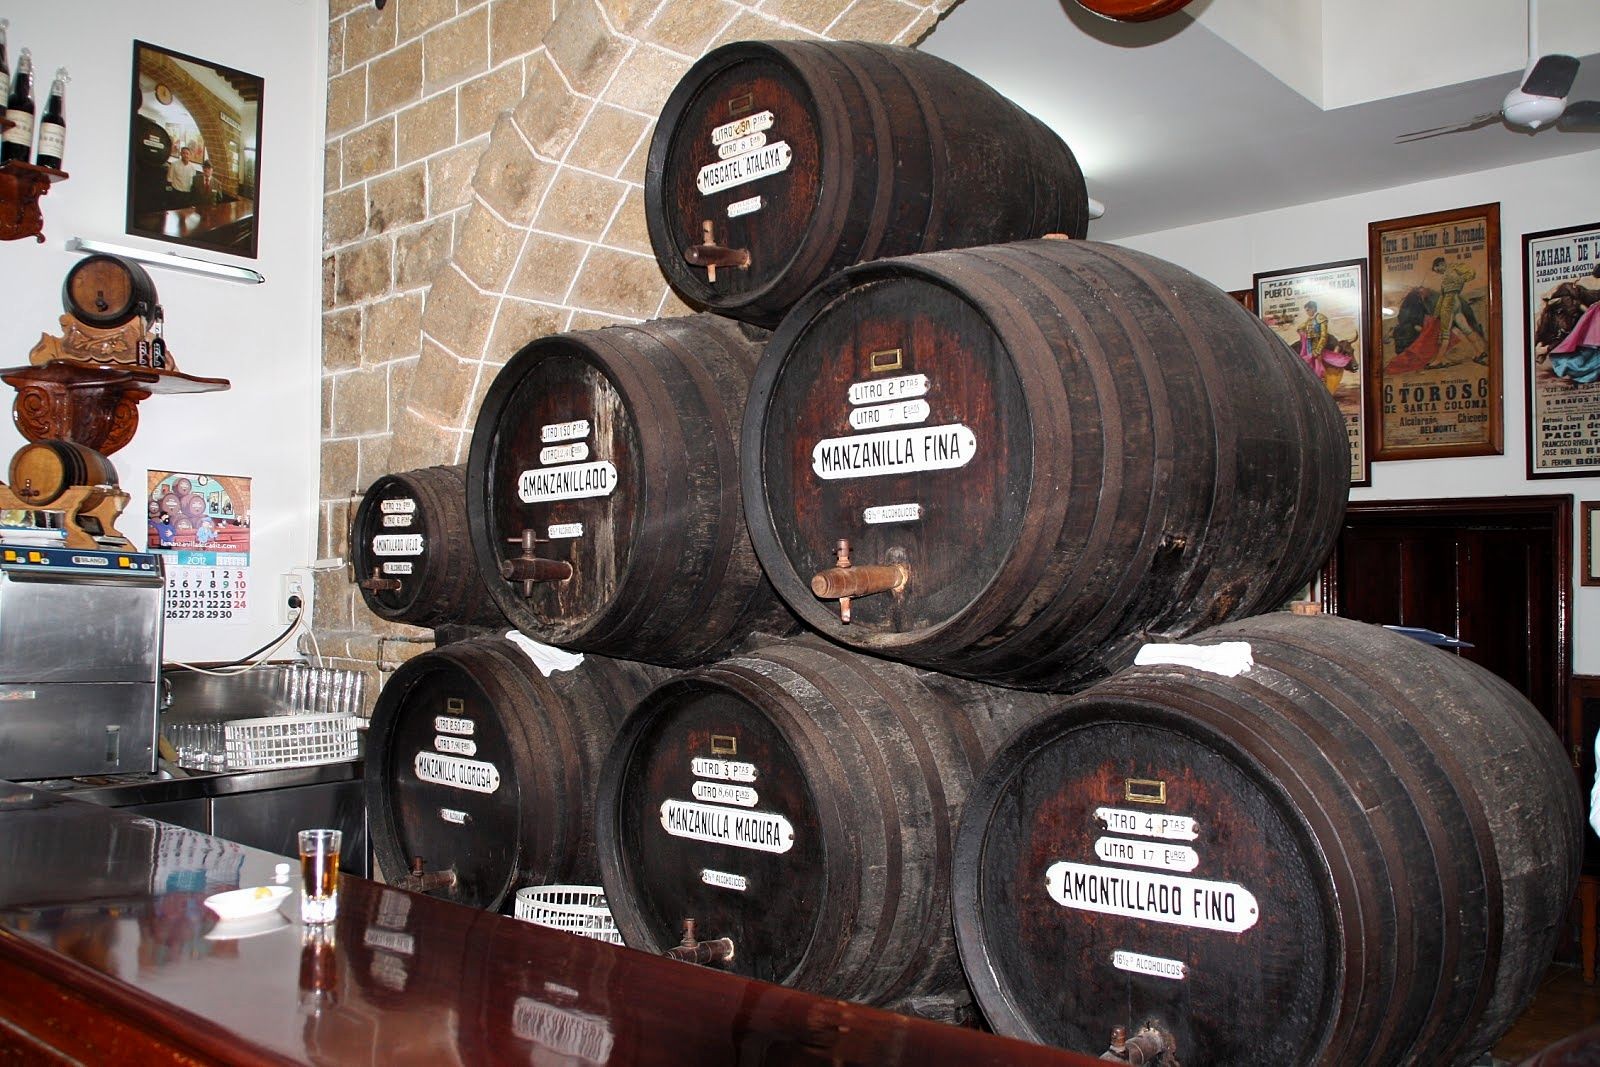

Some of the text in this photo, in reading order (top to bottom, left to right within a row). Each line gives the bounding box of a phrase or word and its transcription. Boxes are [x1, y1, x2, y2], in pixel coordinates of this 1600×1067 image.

[714, 125, 733, 142] LITRO
[721, 144, 737, 156] LITRO
[703, 161, 742, 188] MOSCATEL
[1536, 246, 1571, 267] ZAHARA
[1577, 244, 1588, 261] DE
[1572, 263, 1594, 272] AGOSTO
[1264, 288, 1294, 299] PUERTO
[855, 383, 882, 400] LITRO
[888, 382, 895, 396] 2
[1384, 384, 1394, 404] 6
[1398, 383, 1473, 404] TOROS
[1478, 378, 1488, 398] 6
[1384, 399, 1488, 414] DE SANTA COLOMA
[856, 409, 880, 425] LITRO
[889, 408, 895, 419] 7
[1542, 423, 1581, 431] Rafael
[1544, 431, 1582, 439] PACO
[1541, 440, 1571, 448] FRANCISCO
[1560, 447, 1581, 455] RIVERA
[821, 432, 960, 472] MANZANILLA FINA
[523, 467, 607, 497] AMANZANILLADO
[882, 506, 917, 519] ALCOHOLICOS
[170, 580, 246, 588] 5 6 7 8 9 10
[167, 590, 246, 598] 12 13 14 15 16 17
[419, 757, 491, 788] MANZANILLA OLOROSA
[696, 762, 719, 775] LITRO
[724, 764, 729, 776] 3
[697, 785, 717, 798] LITRO
[668, 806, 781, 846] MANZANILLA MADURA
[1145, 817, 1153, 831] 4
[1104, 842, 1134, 860] LITRO
[1143, 849, 1154, 860] 17
[1063, 871, 1235, 923] AMONTILLADO FINO
[1136, 957, 1180, 976] ALCOHOLICOS
